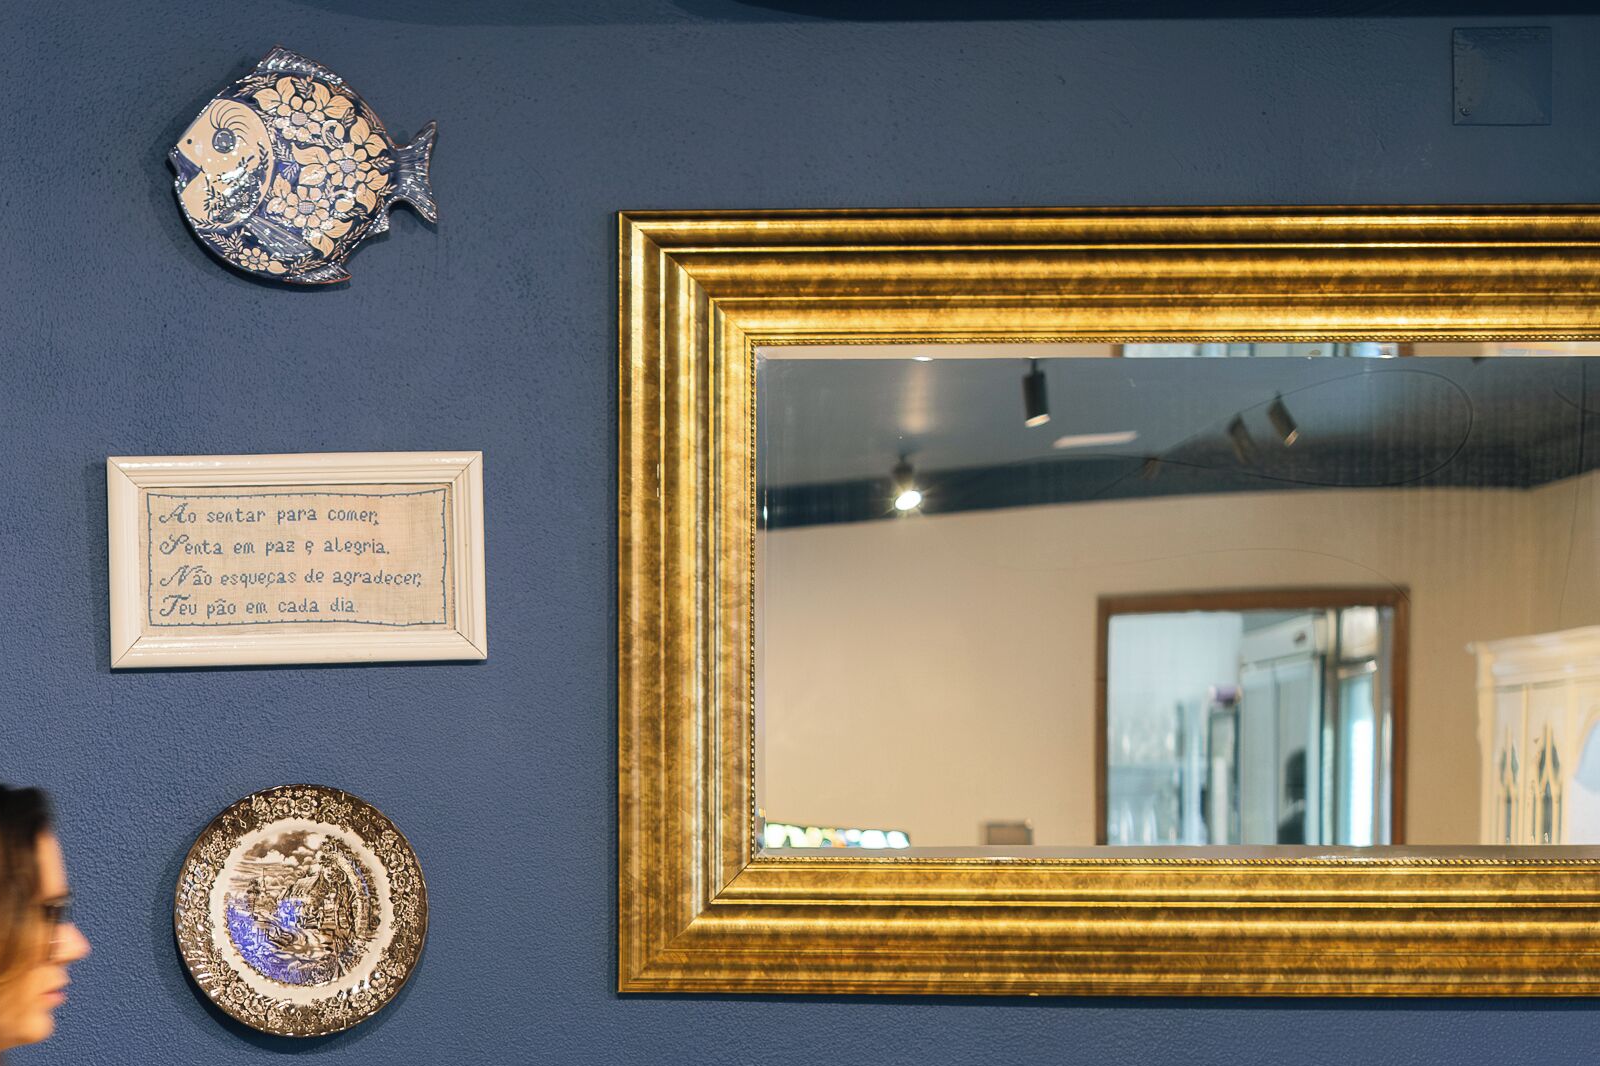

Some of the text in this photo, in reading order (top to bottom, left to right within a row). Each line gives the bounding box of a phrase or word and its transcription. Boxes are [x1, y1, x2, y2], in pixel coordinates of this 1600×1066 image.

[159, 502, 380, 526] Ao sentar para comer,
[159, 533, 224, 556] Senta
[233, 541, 256, 555] em
[265, 540, 296, 557] paz
[323, 536, 391, 556] alegria.
[159, 564, 422, 588] Não esqueças de agradecer,
[159, 594, 360, 619] Teu pão em cada dia.
